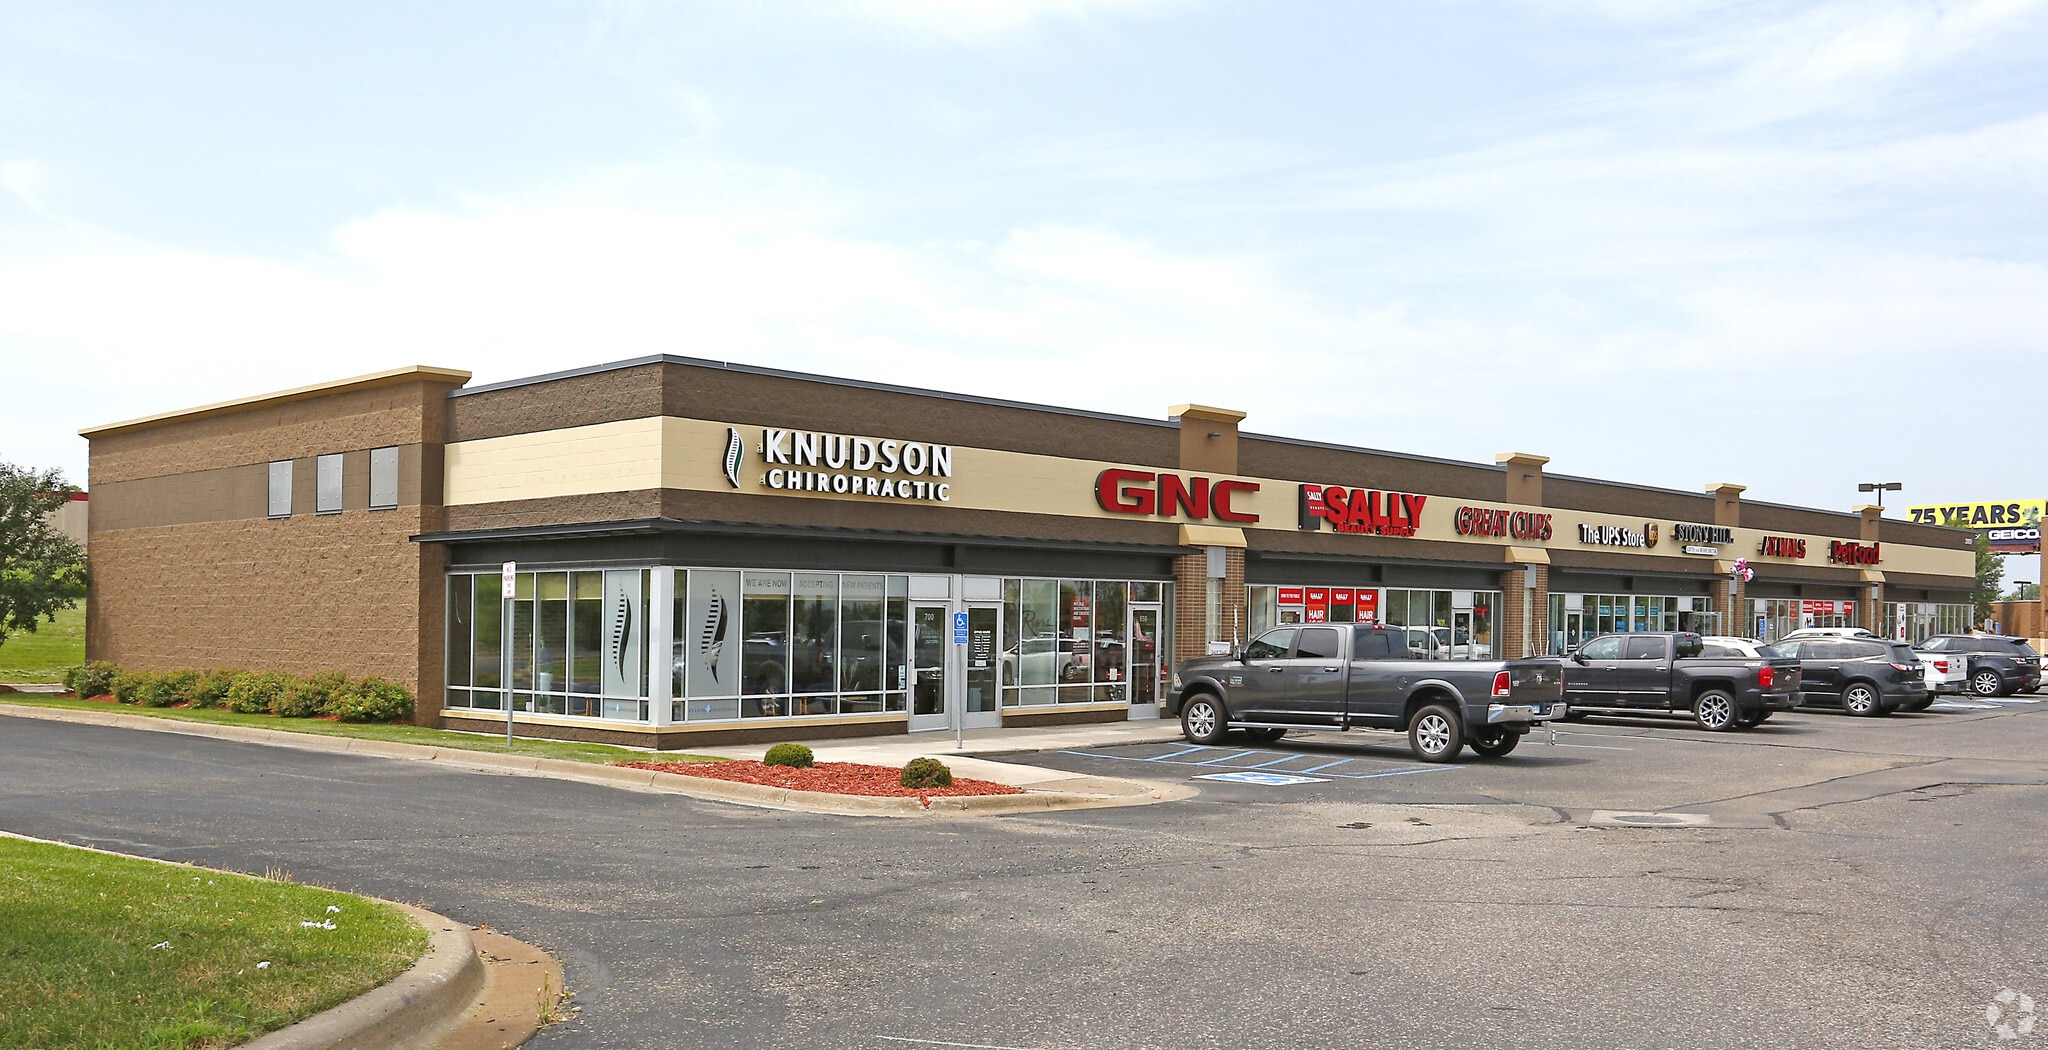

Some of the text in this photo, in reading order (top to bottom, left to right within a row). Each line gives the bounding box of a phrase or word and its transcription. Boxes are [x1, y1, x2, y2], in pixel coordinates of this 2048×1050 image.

[763, 429, 952, 478] KNUDSON
[765, 469, 951, 502] CHIROPRACTIC
[1095, 468, 1260, 522] GNC
[1306, 490, 1322, 501] SALLY
[1323, 486, 1427, 529] SALLY
[1910, 503, 2021, 525] 75 YEARS
[1335, 523, 1417, 537] BEAUTY SUPPLY
[1454, 506, 1554, 541] GREAT CLIPS
[1580, 523, 1646, 547] The UPS Store
[1676, 524, 1734, 544] STONY HILL
[746, 579, 884, 590] WE ARE NOW ACCEPTING NEW PATIENTS
[1310, 592, 1324, 600] SALLY
[1335, 593, 1349, 601] SALLY
[924, 613, 935, 621] 700
[1308, 610, 1325, 620] HAIR
[1359, 610, 1374, 620] HAIR
